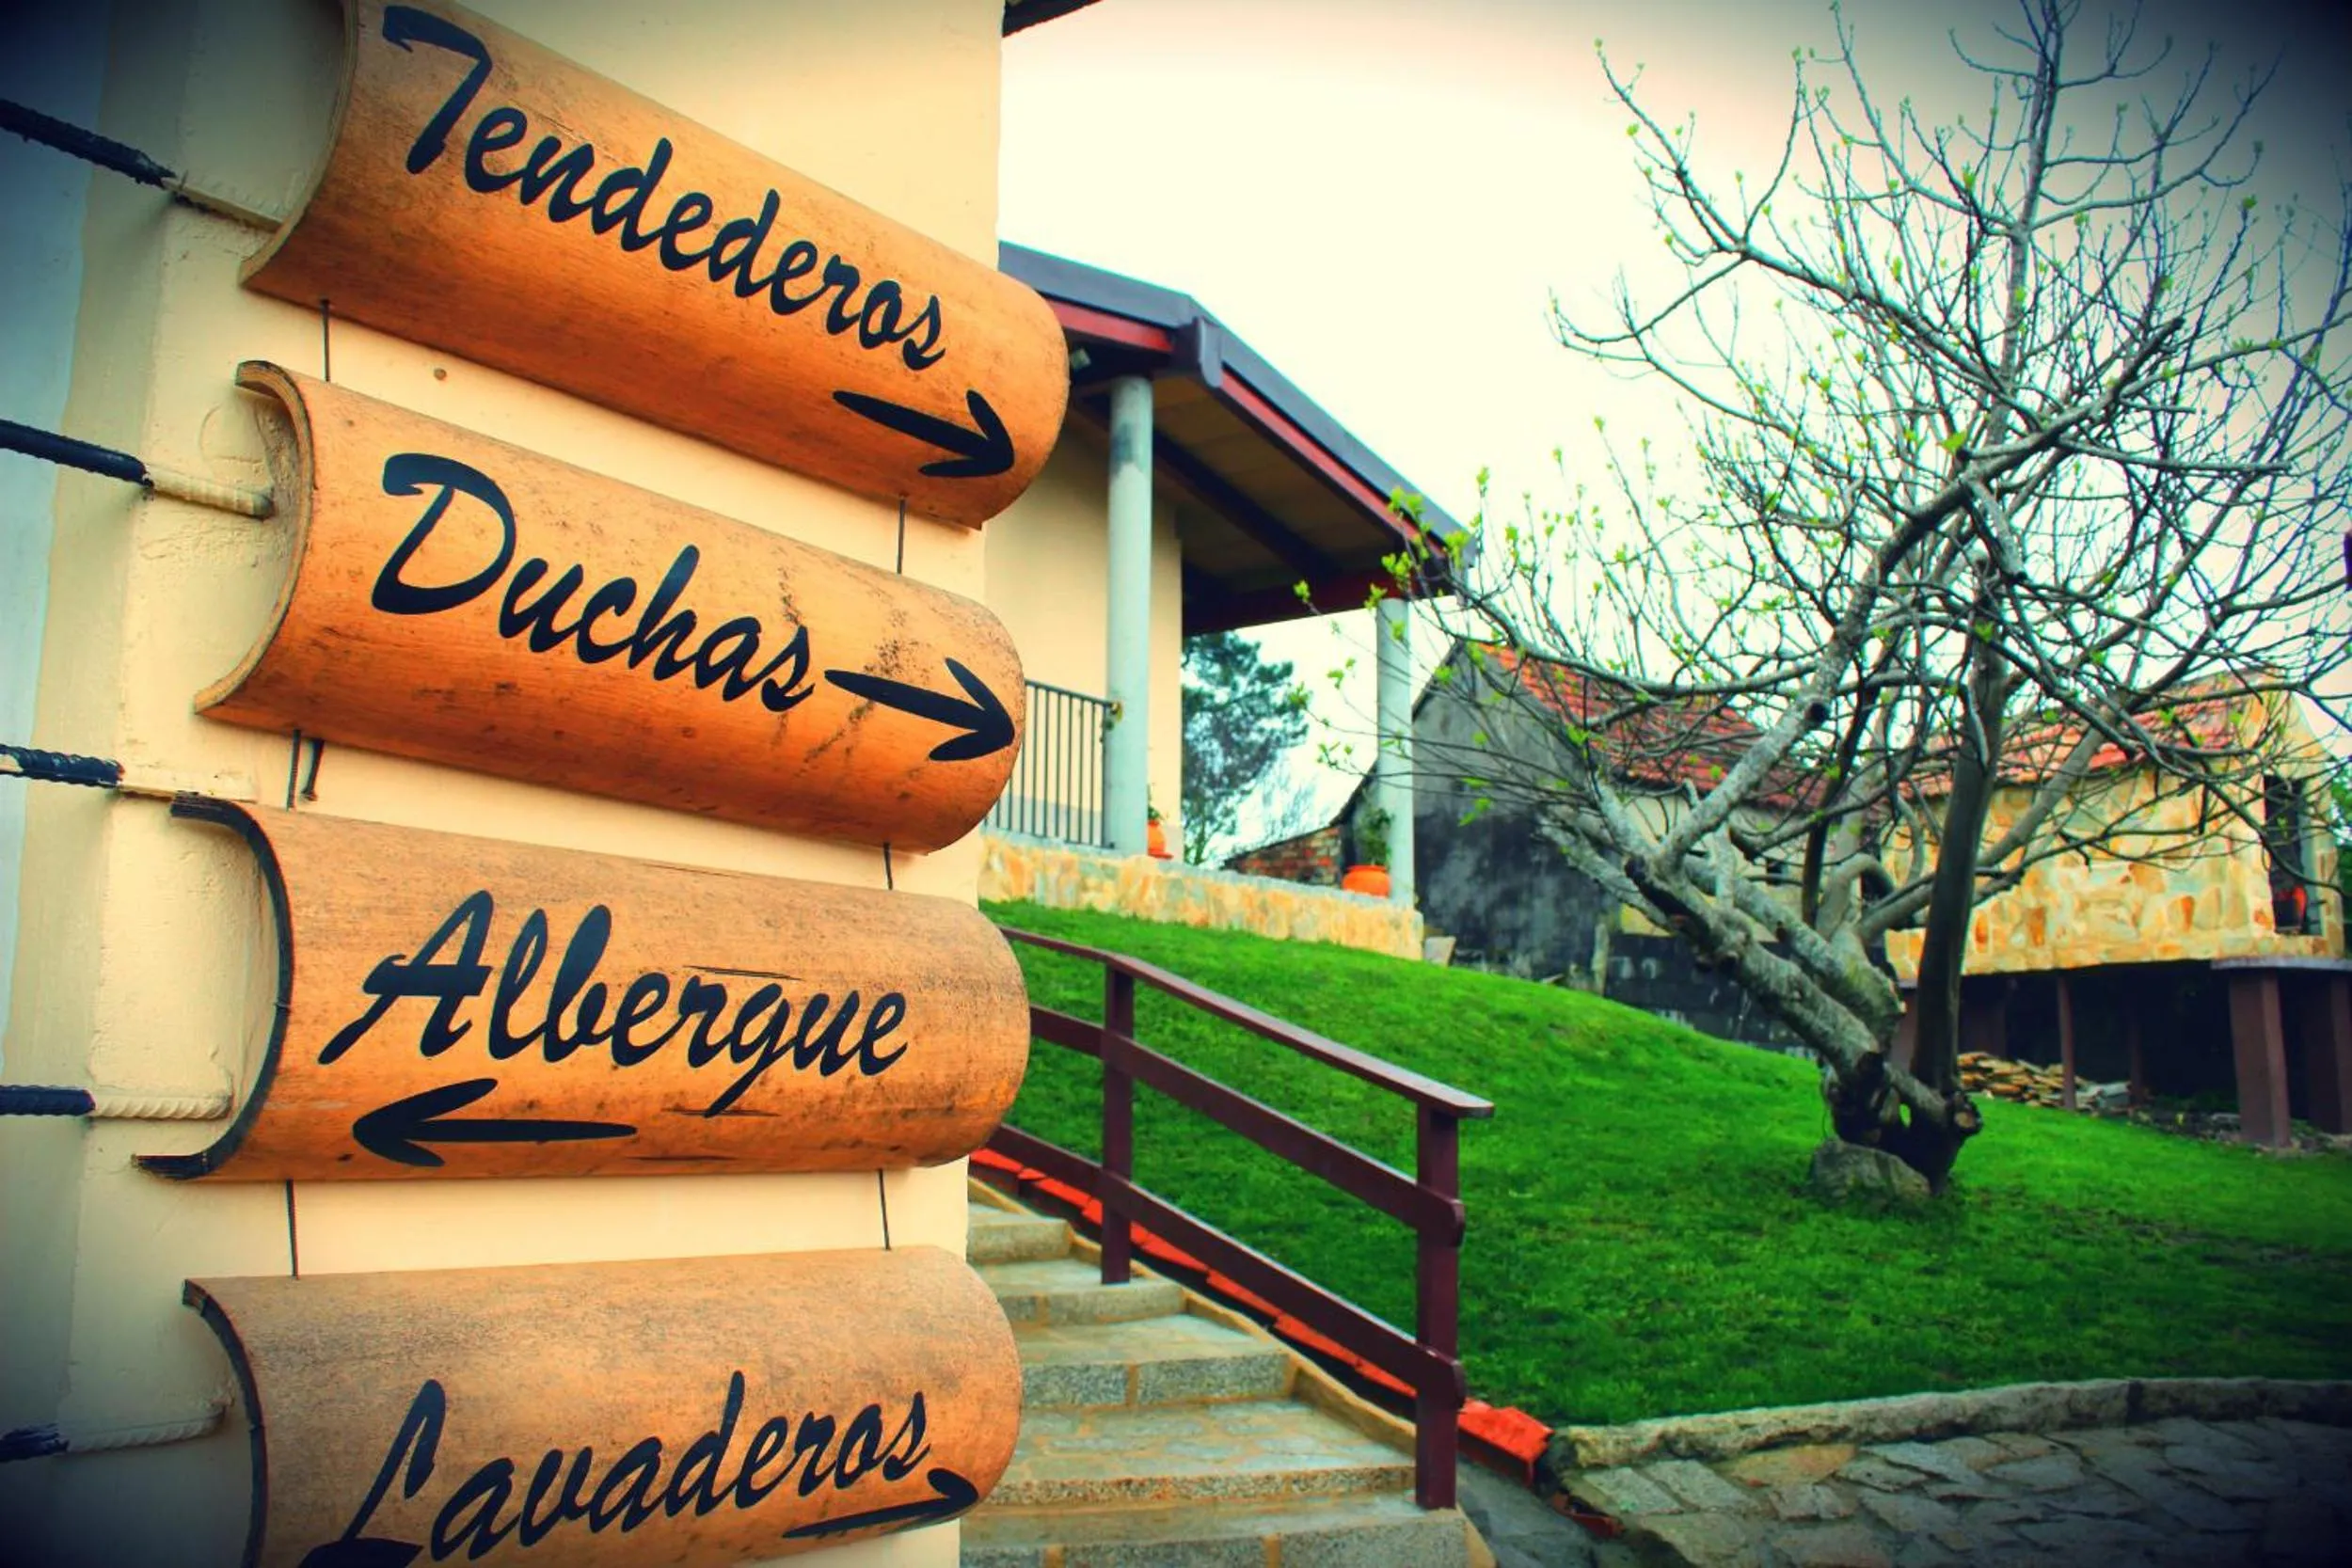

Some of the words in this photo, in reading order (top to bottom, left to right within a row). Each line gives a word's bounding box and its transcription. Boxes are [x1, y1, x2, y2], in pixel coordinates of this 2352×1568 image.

[384, 5, 945, 370] Tendederos
[373, 453, 814, 712] Duchas
[318, 890, 907, 1118] Albergue
[299, 1370, 930, 1567] Lavaderos
